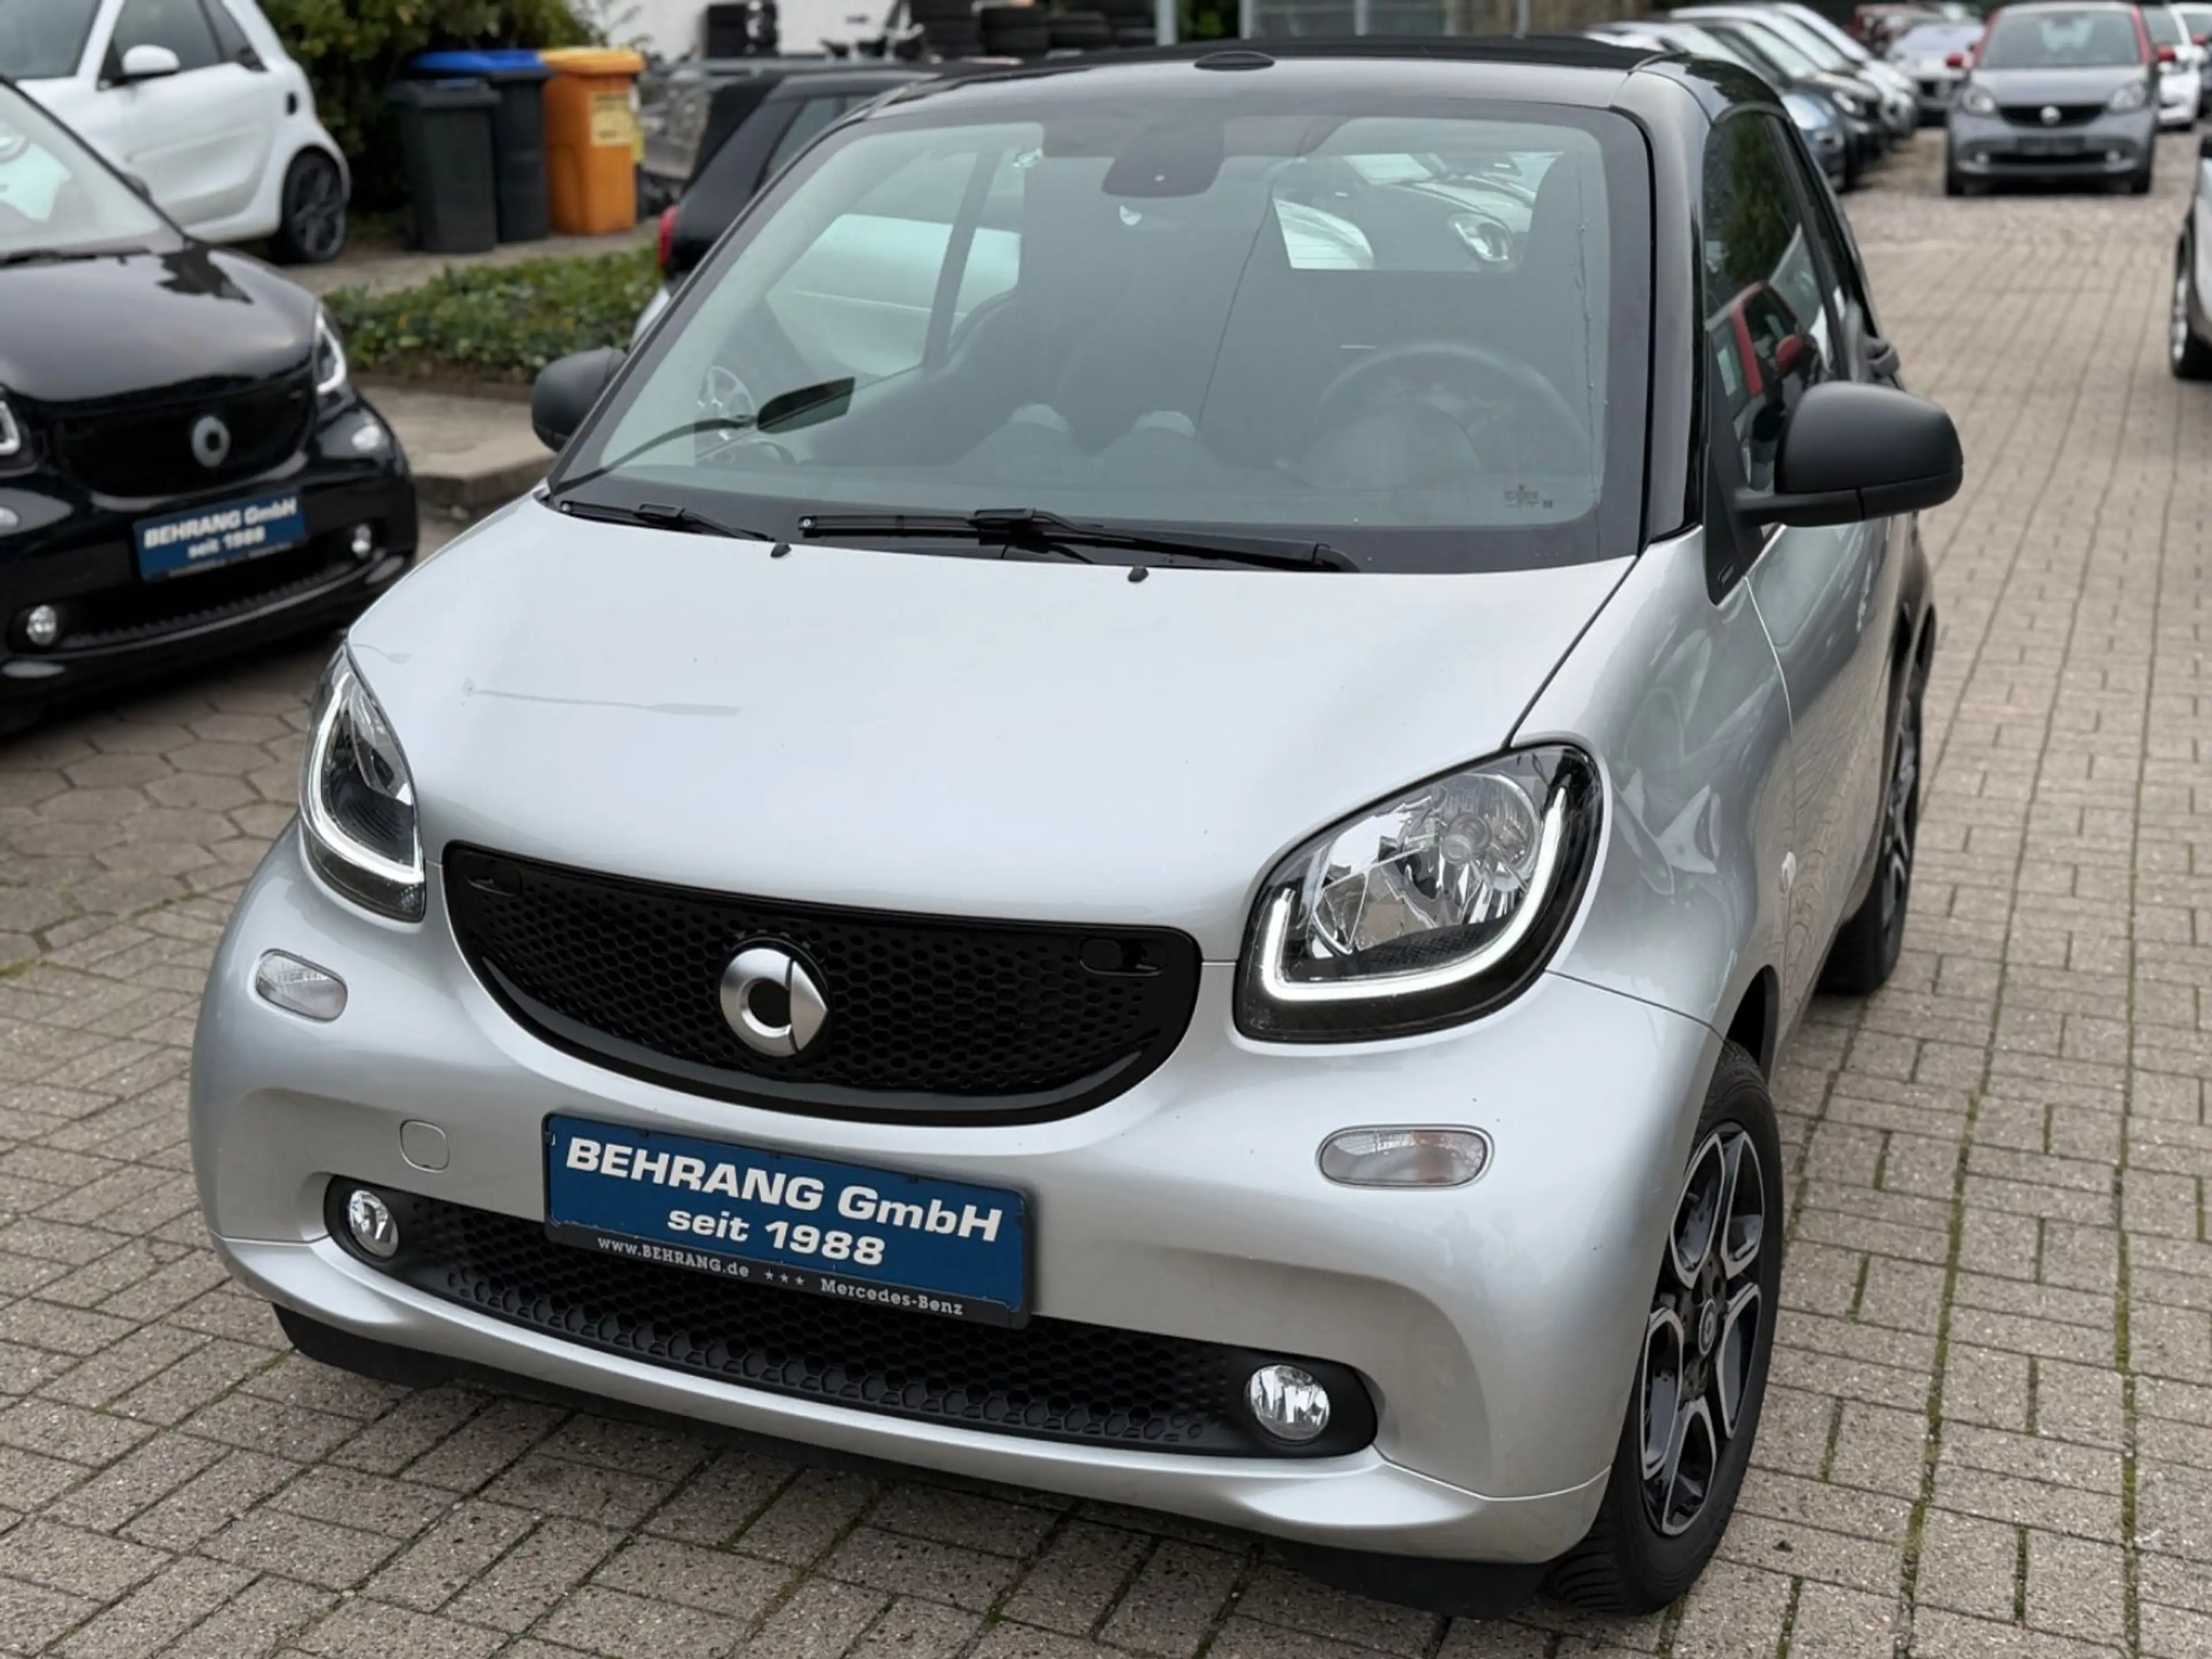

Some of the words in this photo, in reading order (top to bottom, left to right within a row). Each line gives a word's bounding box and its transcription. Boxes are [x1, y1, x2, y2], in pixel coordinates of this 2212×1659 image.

[145, 510, 241, 548] BEHRANG
[244, 498, 297, 525] GmbH
[188, 538, 219, 558] seit
[222, 525, 266, 549] 1988
[566, 1137, 825, 1211] BEHRANG
[838, 1185, 1002, 1242] GmbH
[667, 1210, 749, 1242] seit
[764, 1221, 885, 1265] 1988
[597, 1237, 749, 1278] www.BEHRANG.de
[821, 1278, 964, 1316] Mercedes-Benz
